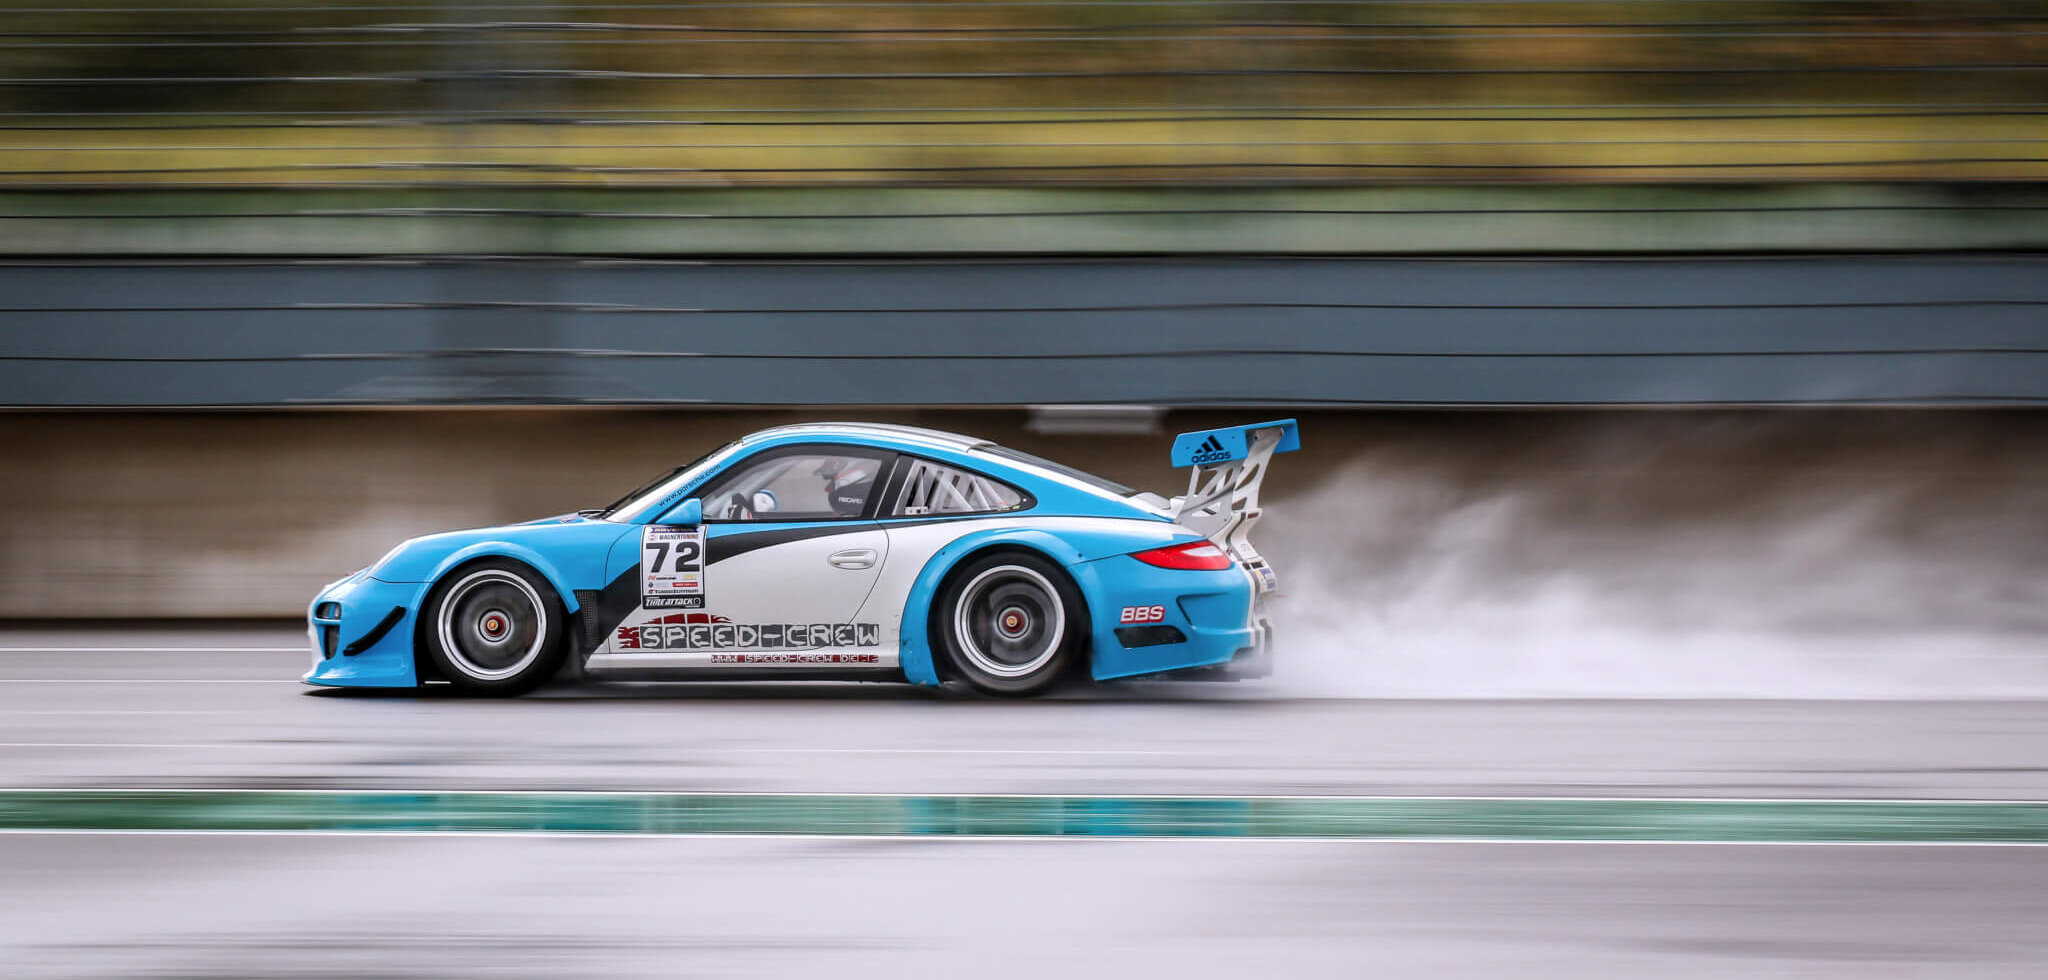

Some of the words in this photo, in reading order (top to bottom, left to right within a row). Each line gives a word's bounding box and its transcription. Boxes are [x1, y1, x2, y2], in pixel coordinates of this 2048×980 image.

[1192, 451, 1232, 463] adidas
[659, 465, 720, 506] www.porsche.com
[646, 541, 700, 573] 72
[1120, 605, 1164, 621] BBS
[641, 625, 879, 648] SPEED-CREW
